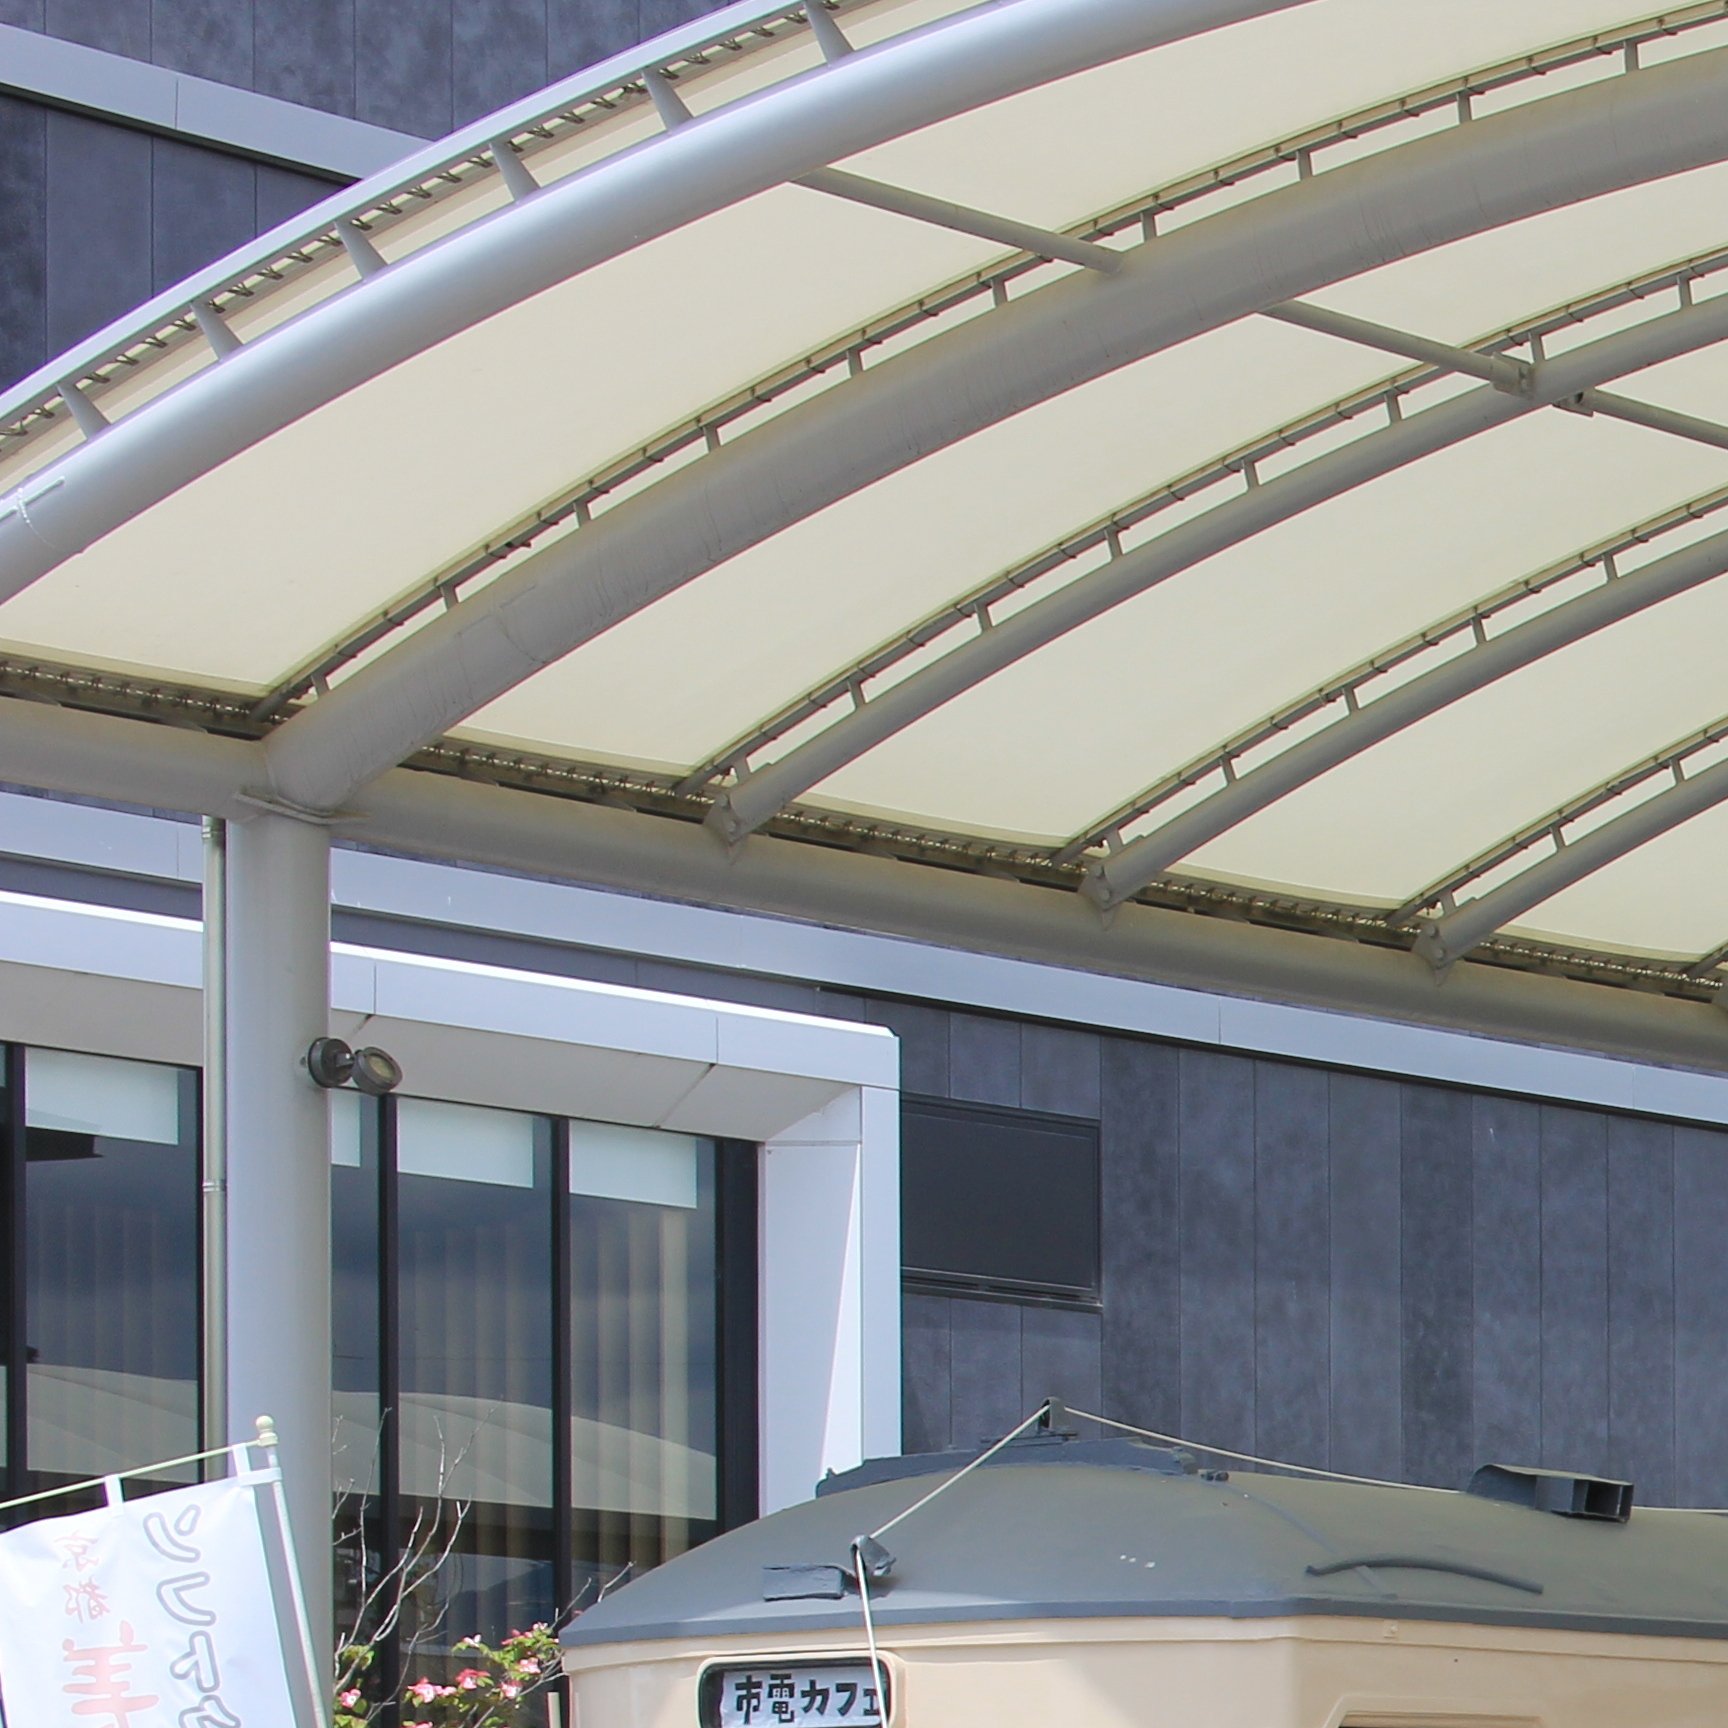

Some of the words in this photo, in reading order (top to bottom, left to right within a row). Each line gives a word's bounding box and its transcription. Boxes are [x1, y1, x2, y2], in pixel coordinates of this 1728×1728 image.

[735, 1673, 880, 1725] 市電カフェ
